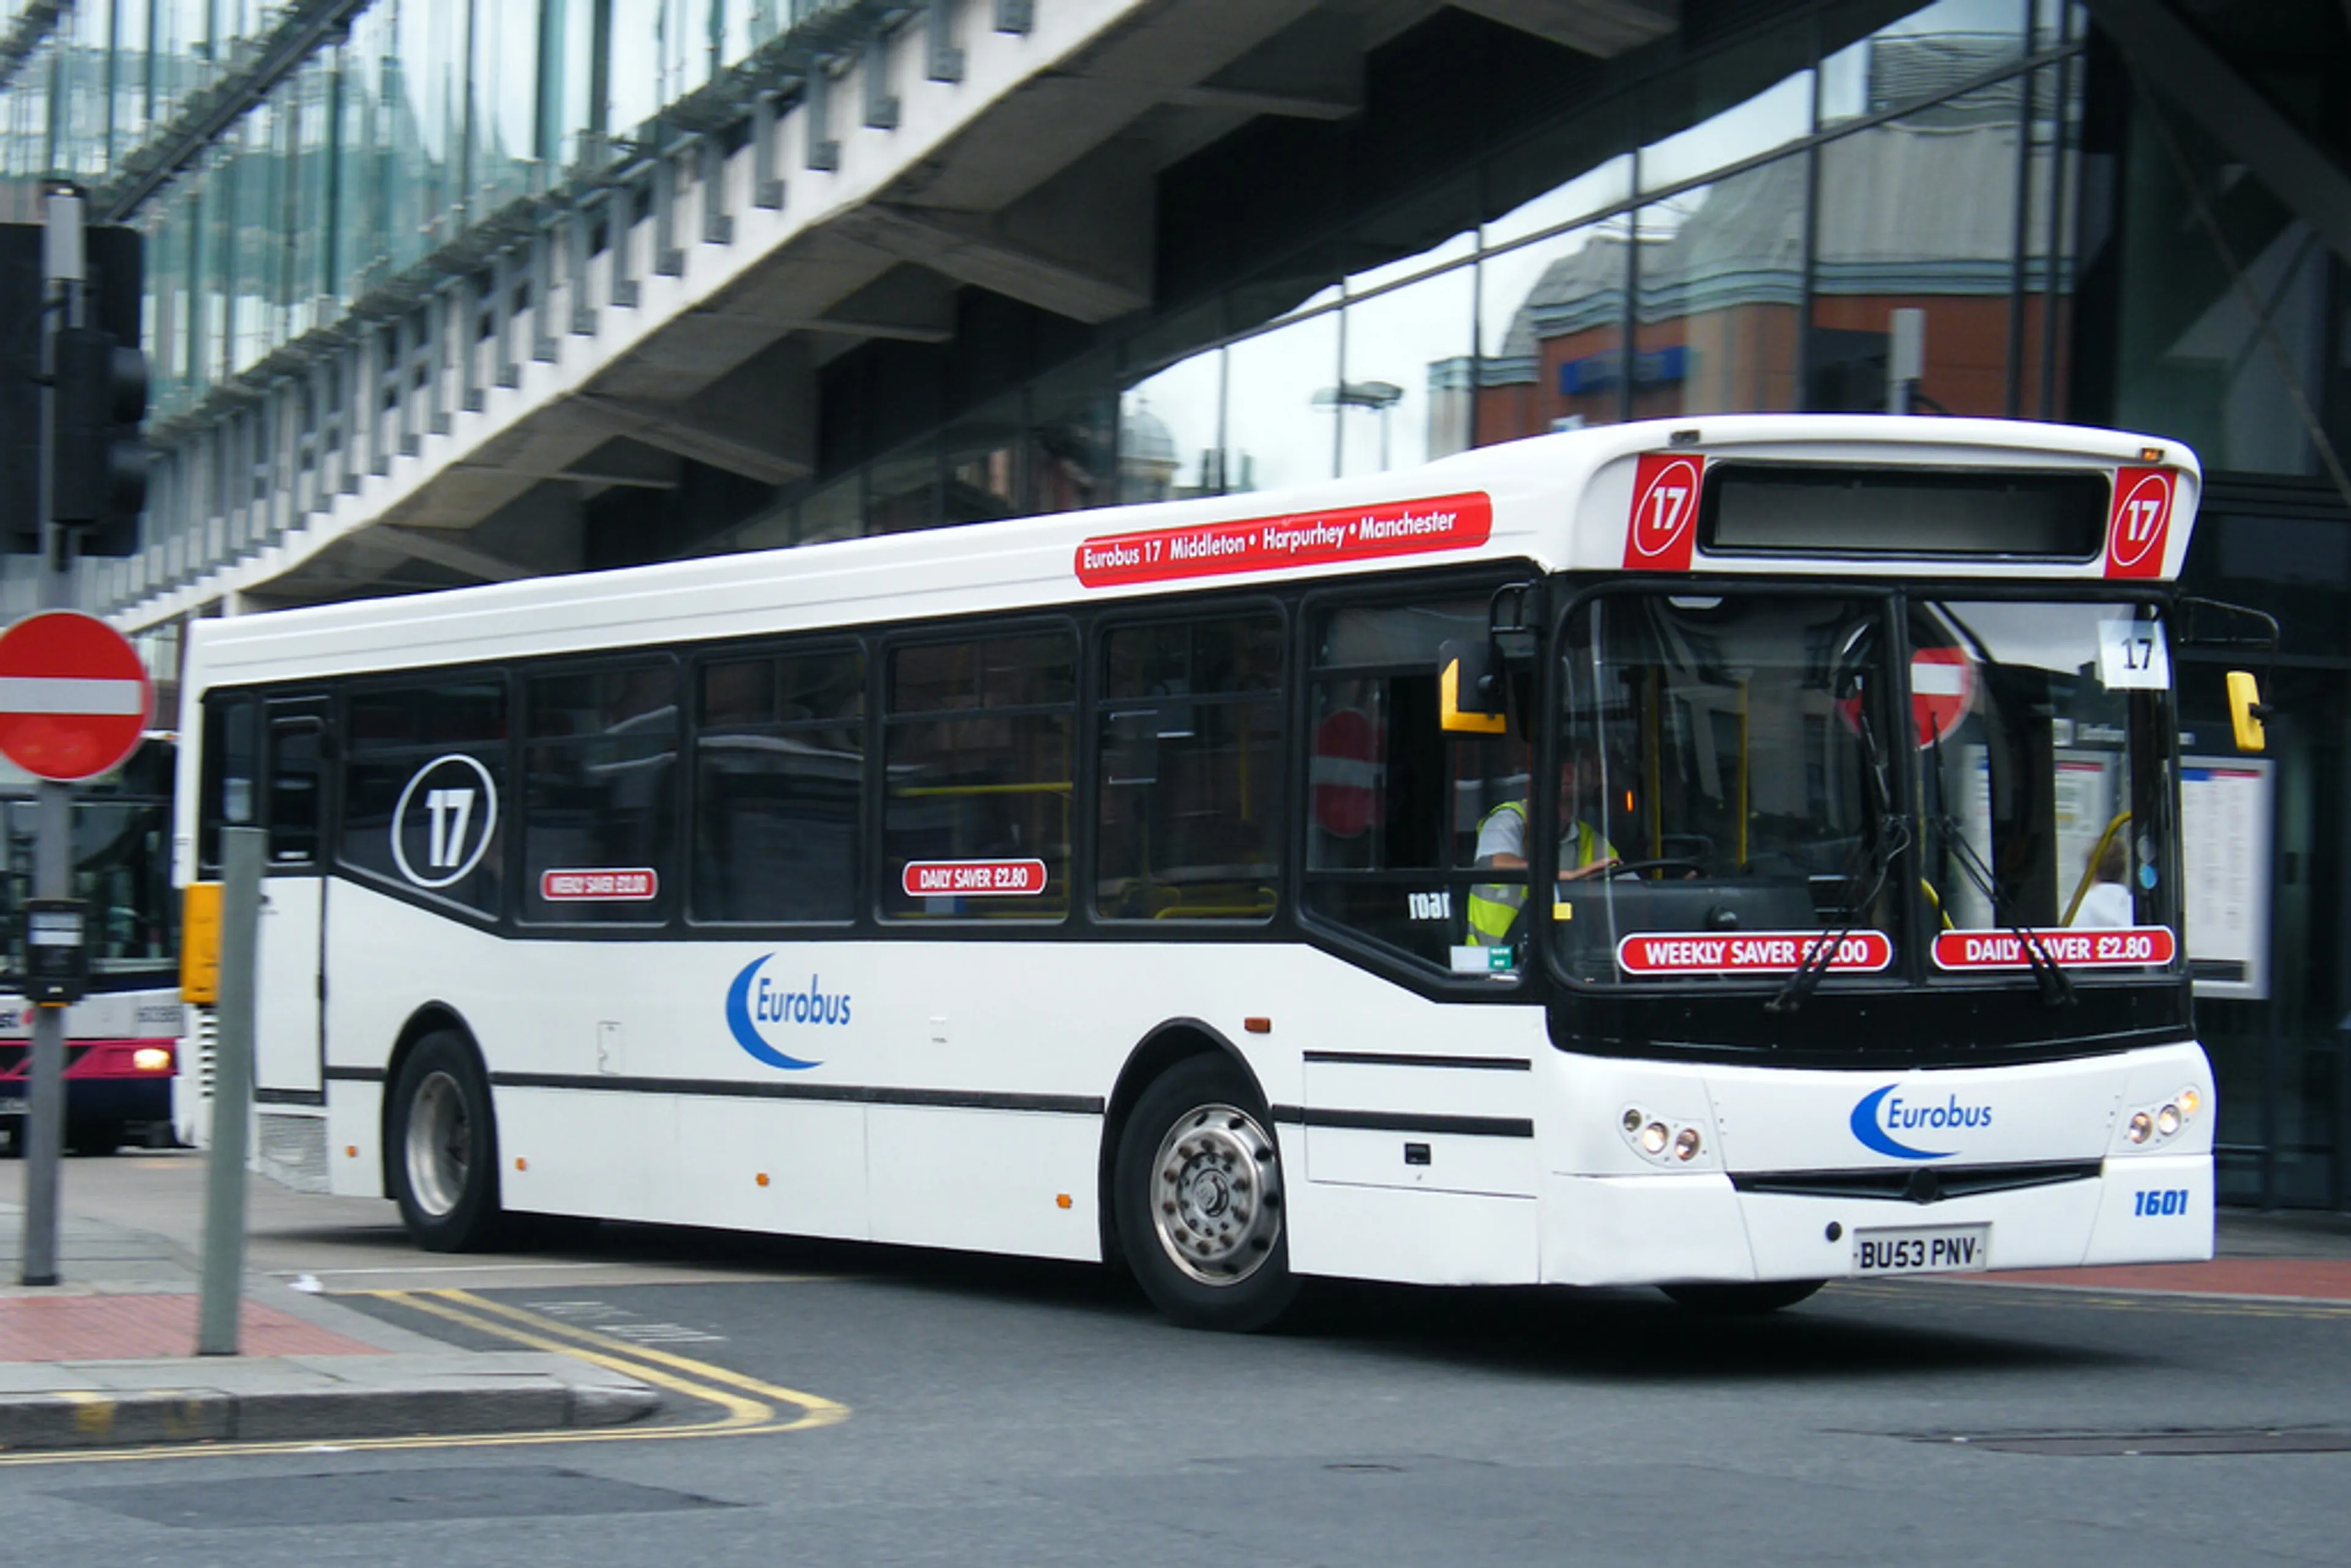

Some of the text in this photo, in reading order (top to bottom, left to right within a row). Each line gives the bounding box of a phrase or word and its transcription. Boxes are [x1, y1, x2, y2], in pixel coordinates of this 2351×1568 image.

[1653, 486, 1688, 530] 17
[2128, 500, 2159, 541] 17
[1083, 511, 1456, 569] Eurobus 17 Middleton Harpurhey Manchester
[2123, 637, 2153, 669] 17
[426, 789, 474, 867] 17
[920, 867, 1028, 889] DAILY SAVER £2.80
[1408, 892, 1450, 920] roar
[1644, 941, 1726, 966] WEEKLY
[1731, 940, 1796, 964] SAVER
[1965, 936, 2151, 961] DAILY SAVER £2.80
[757, 973, 851, 1025] Eurobus
[1887, 1093, 1992, 1128] Eurobus
[2134, 1190, 2188, 1217] 1601
[1860, 1237, 1976, 1269] BU53 PNV
